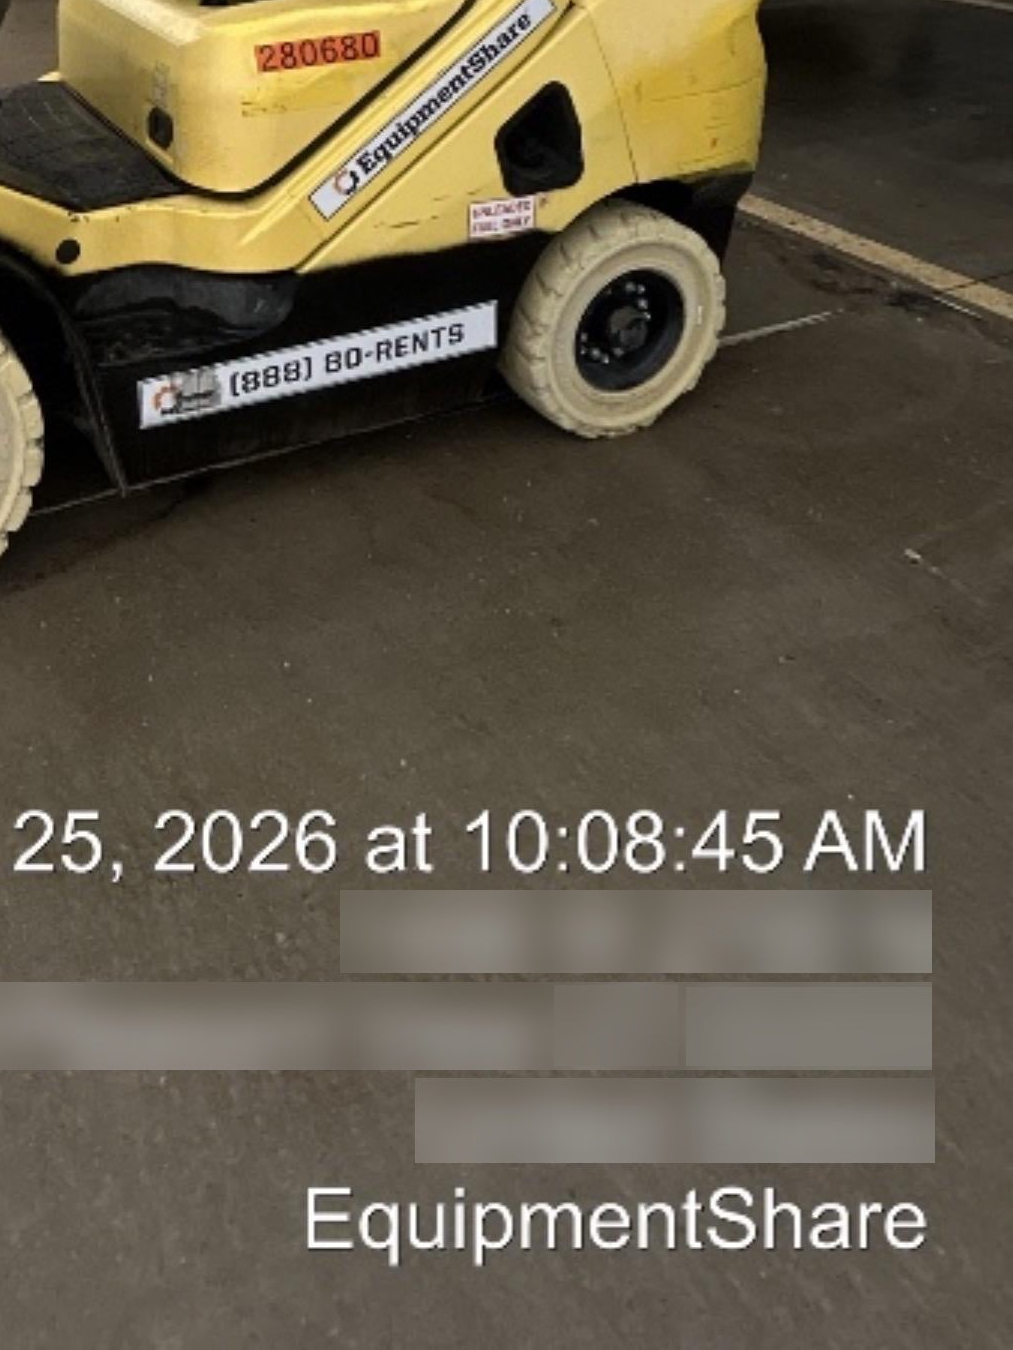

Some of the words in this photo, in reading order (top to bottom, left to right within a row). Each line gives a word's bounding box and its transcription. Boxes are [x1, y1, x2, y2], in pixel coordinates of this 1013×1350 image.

[259, 32, 379, 71] 280680
[356, 11, 532, 177] EquipmentShare
[229, 356, 313, 397] (888)
